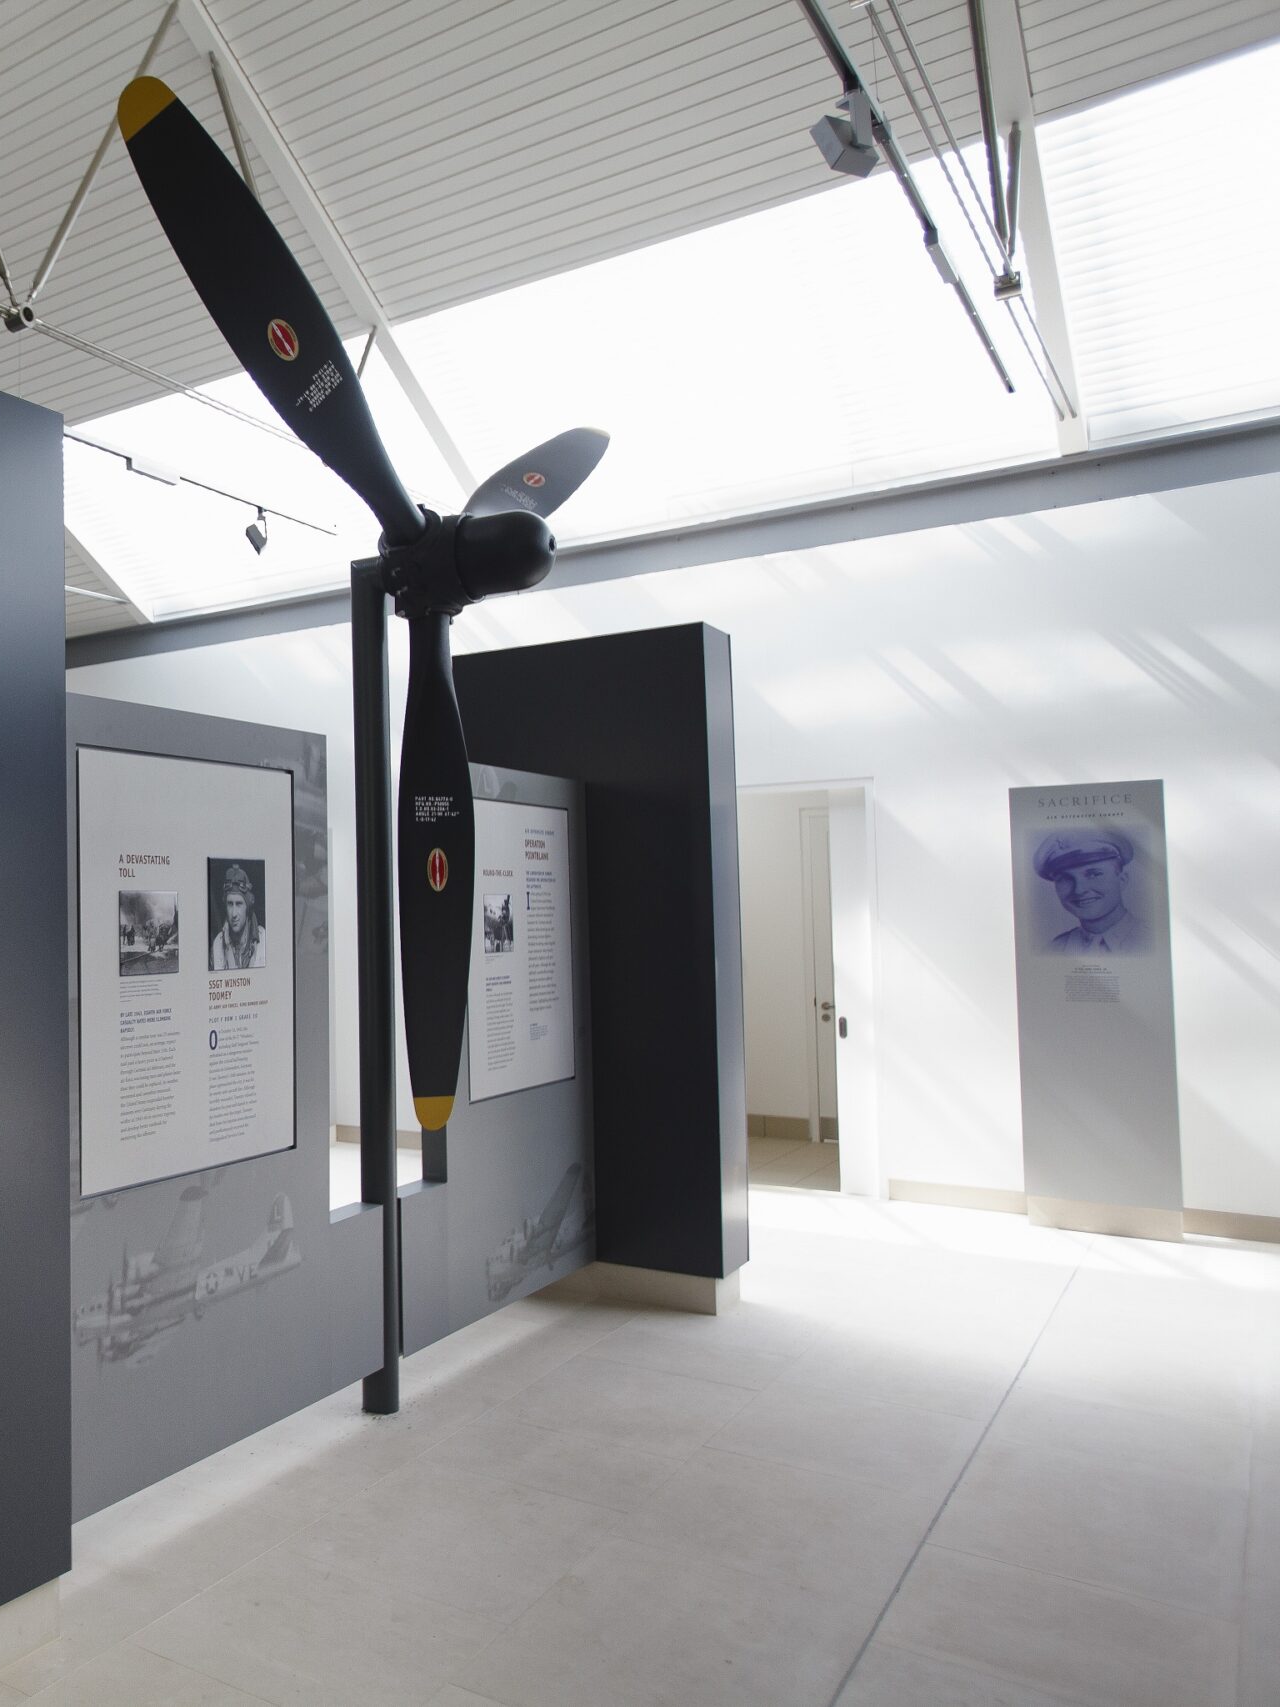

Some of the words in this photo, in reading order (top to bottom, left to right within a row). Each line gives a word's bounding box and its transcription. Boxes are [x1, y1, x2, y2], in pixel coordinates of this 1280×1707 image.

[1037, 793, 1133, 809] SACRIFICE
[524, 839, 546, 849] OPERATION
[119, 853, 124, 864] A
[126, 854, 171, 865] DEVASTATING
[119, 867, 136, 878] TOLL
[209, 979, 223, 990] SSGT
[224, 977, 251, 988] WINSTON
[209, 990, 232, 1001] TOOMEY
